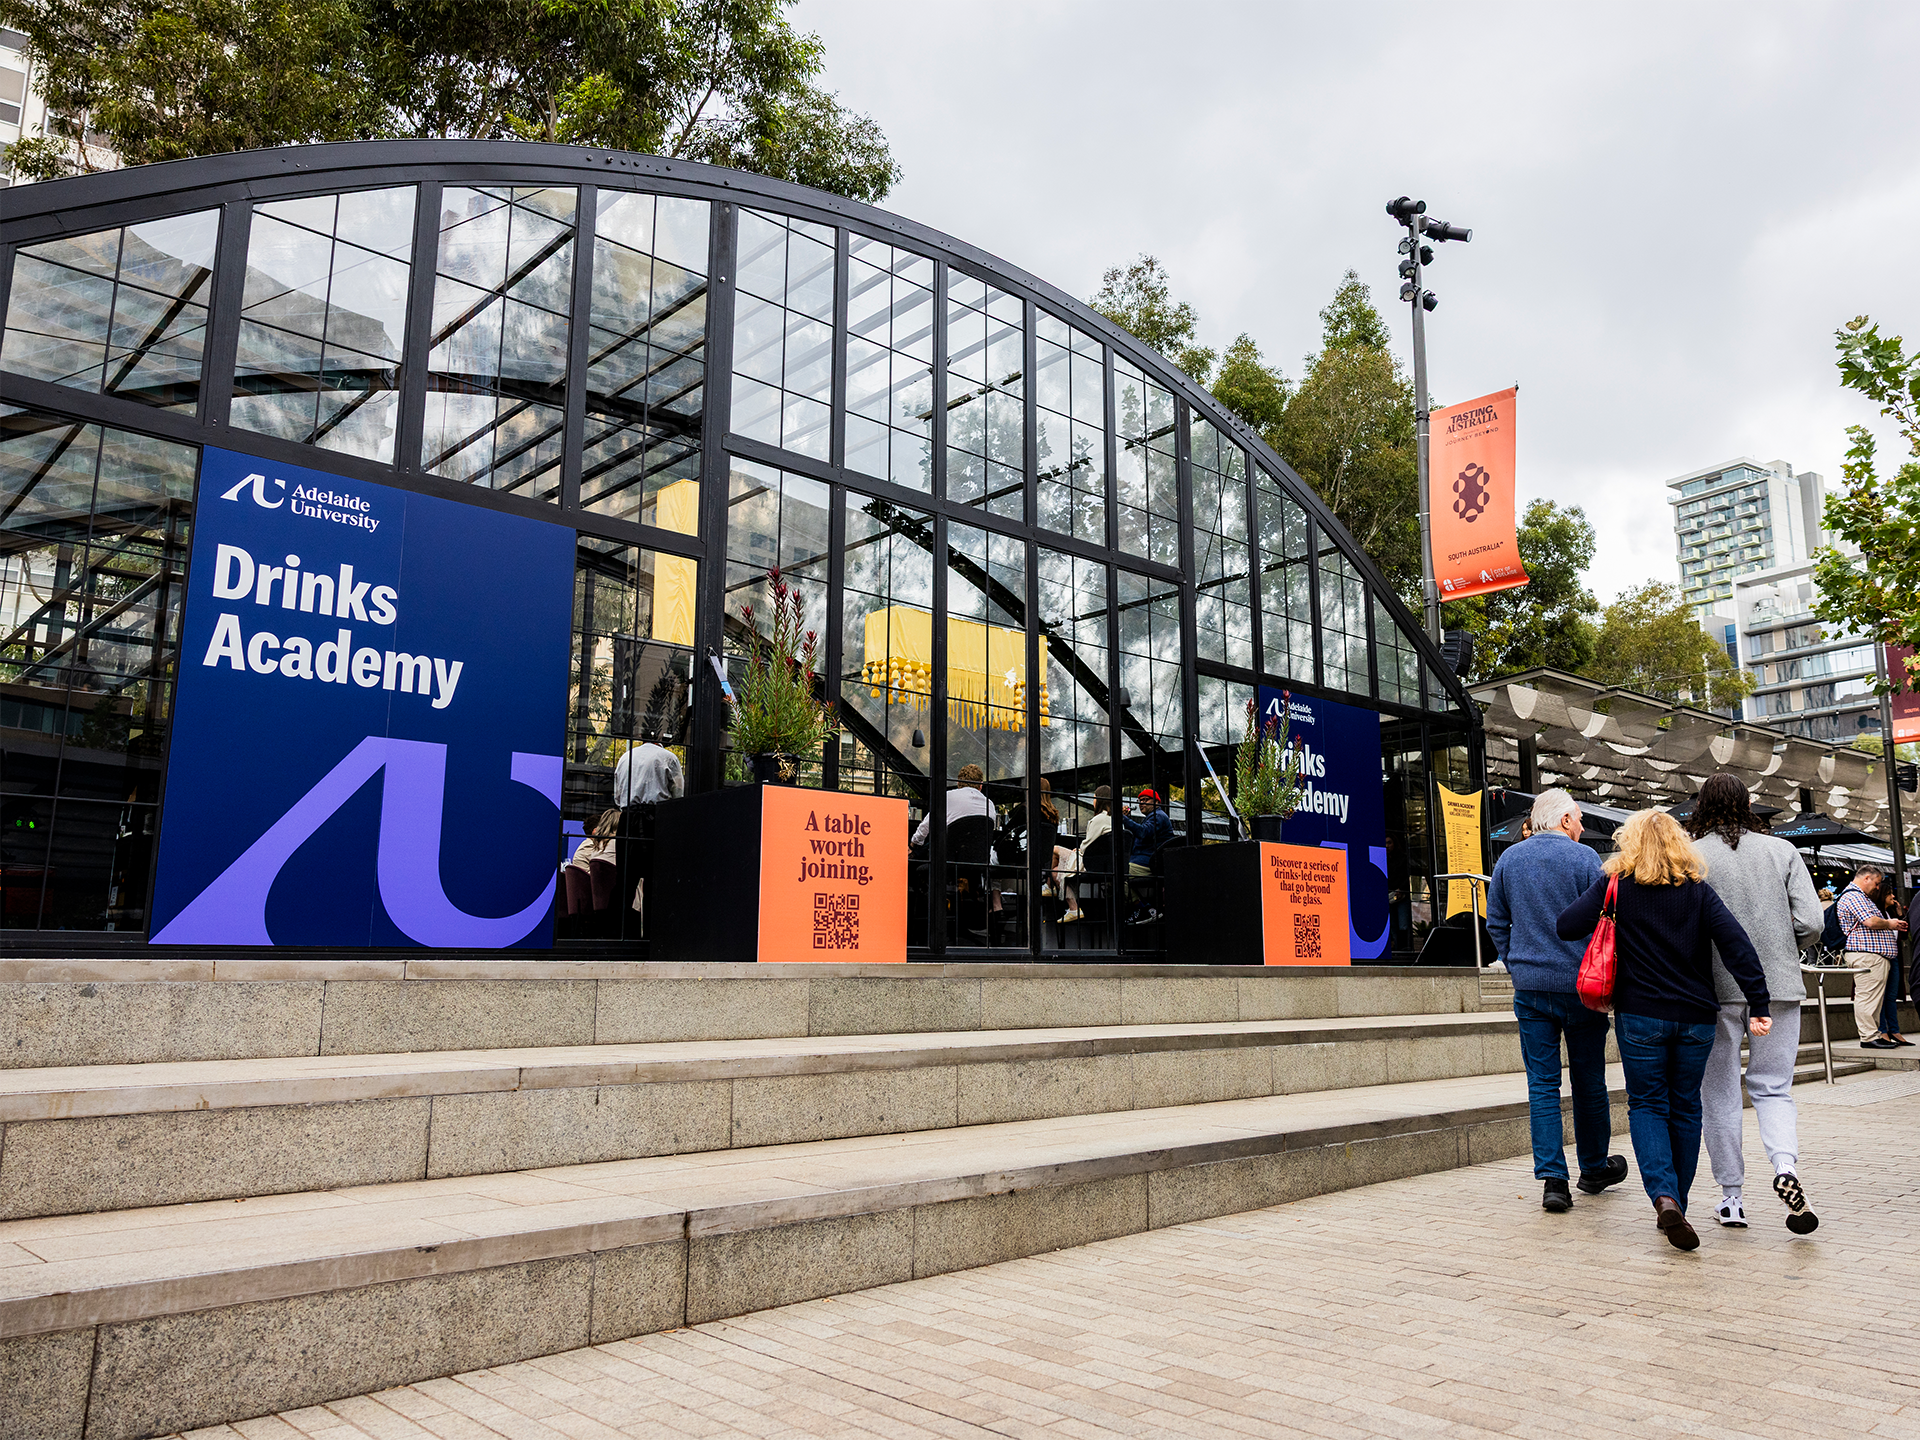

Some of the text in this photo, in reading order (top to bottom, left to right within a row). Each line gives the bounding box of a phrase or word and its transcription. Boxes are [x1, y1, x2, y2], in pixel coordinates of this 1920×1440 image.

[1446, 411, 1498, 435] AUSTRALIA
[1450, 404, 1493, 424] TASTING
[291, 483, 371, 513] Adelaide
[290, 498, 380, 533] University
[1447, 550, 1467, 562] SOUTH
[212, 543, 398, 625] Drinks
[203, 612, 464, 709] Academy
[1268, 779, 1349, 824] ademy
[804, 810, 871, 836] A table
[809, 837, 865, 858] worth
[798, 856, 874, 886] joining.
[1270, 855, 1339, 872] Discover a series of
[1274, 869, 1336, 883] drinks-led events
[1280, 880, 1331, 896] that go beyond
[1290, 892, 1323, 907] the glass.
